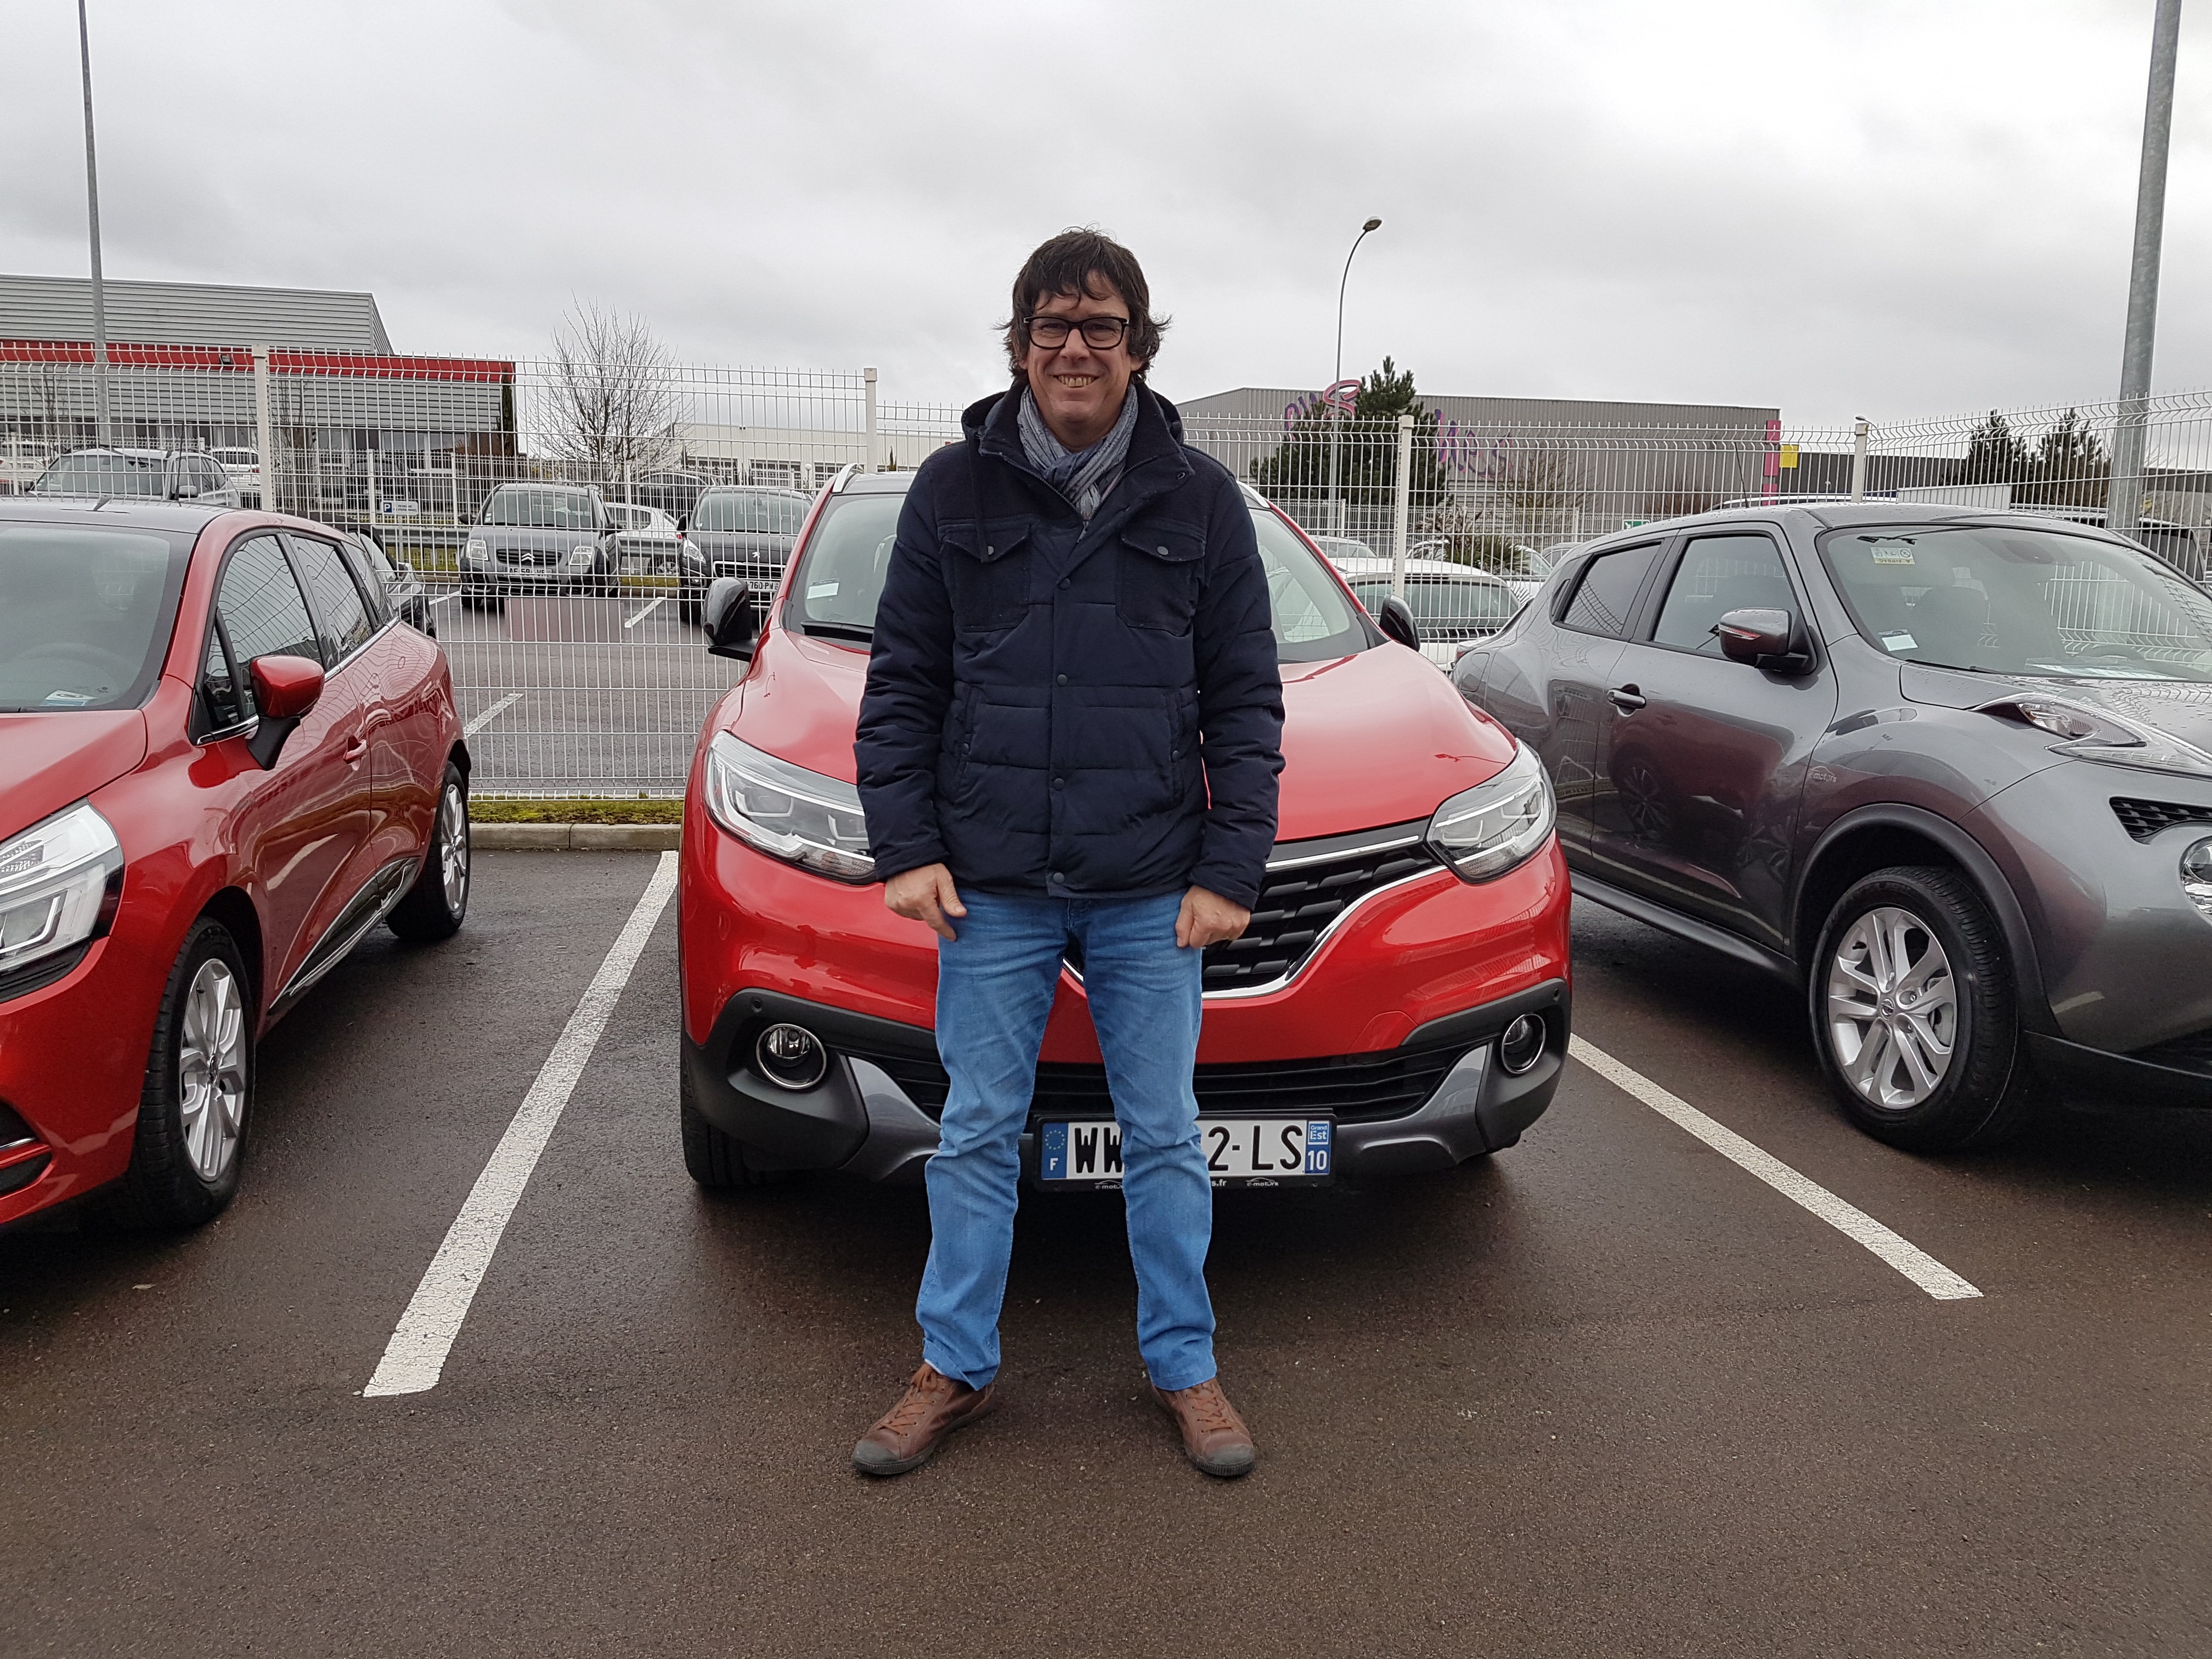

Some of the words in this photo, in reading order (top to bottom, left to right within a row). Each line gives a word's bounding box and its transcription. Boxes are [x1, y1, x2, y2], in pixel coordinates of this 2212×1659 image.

[1310, 1131, 1327, 1139] Est
[1050, 1158, 1059, 1171] F
[1308, 1150, 1327, 1170] 10
